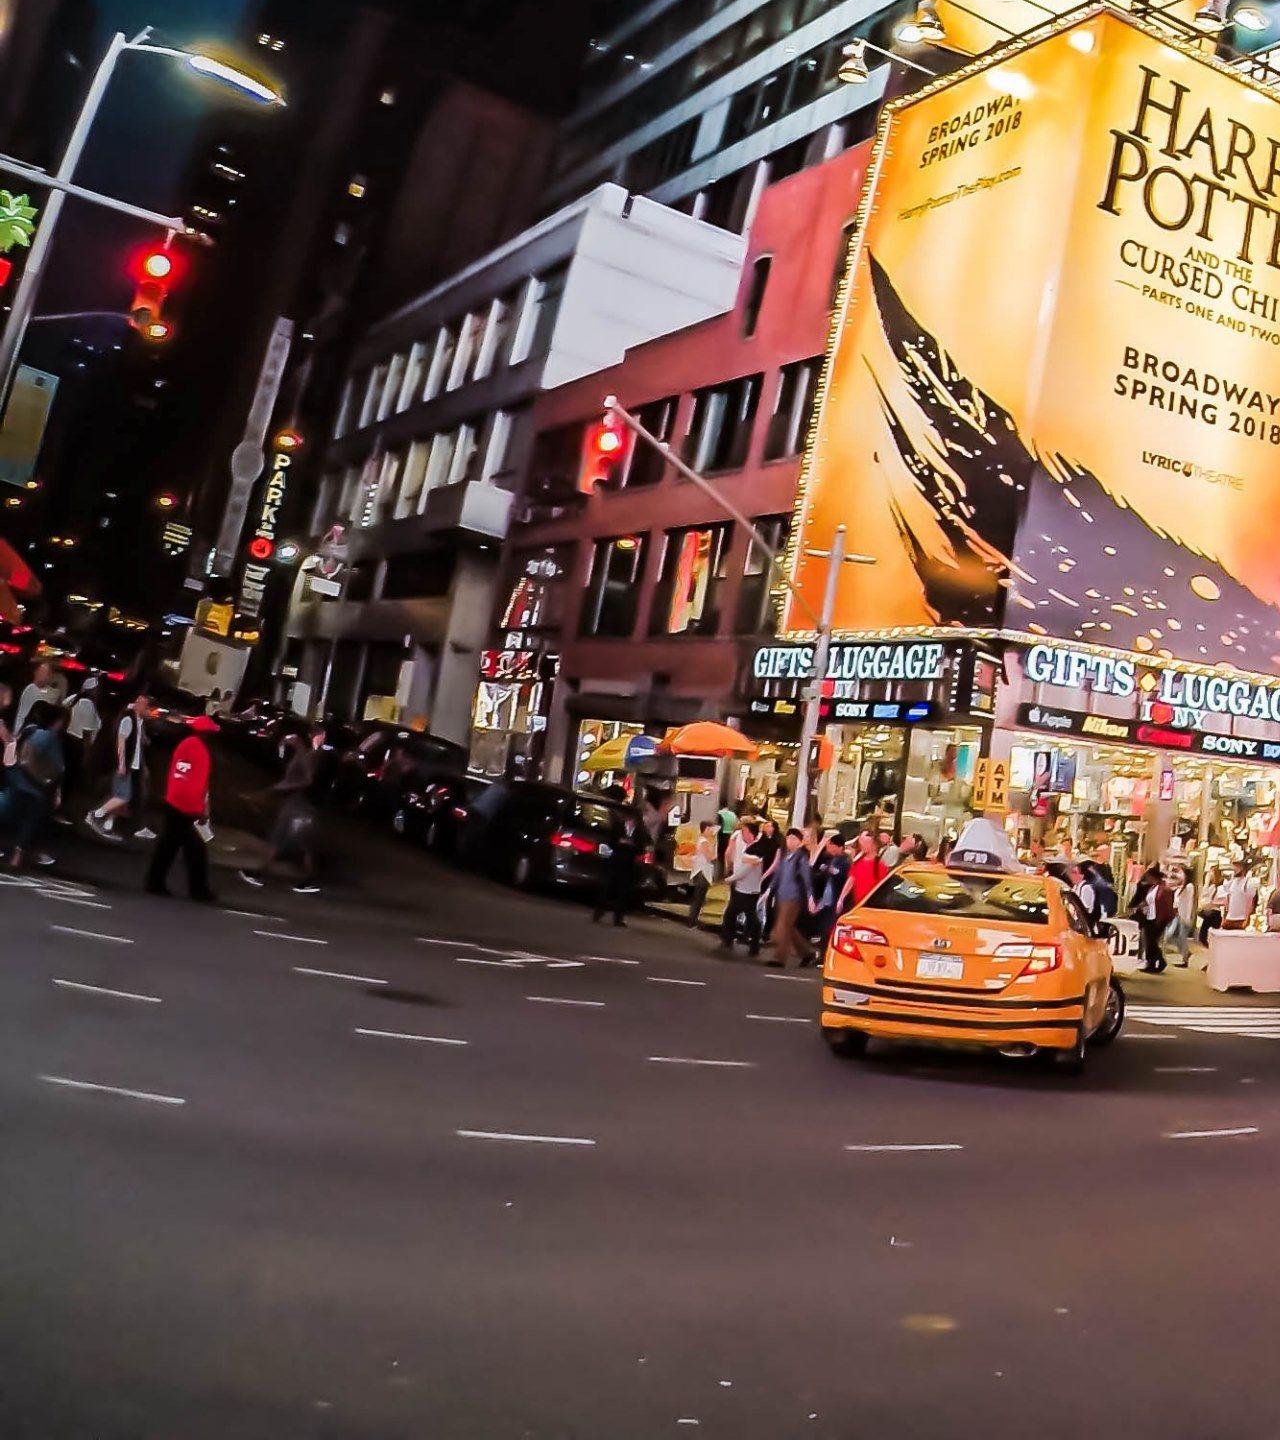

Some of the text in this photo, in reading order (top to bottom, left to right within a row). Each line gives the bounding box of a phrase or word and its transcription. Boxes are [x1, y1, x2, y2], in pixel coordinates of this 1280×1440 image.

[918, 110, 1023, 170] SPRING 2018
[927, 92, 1021, 145] BROADWA
[1119, 239, 1223, 300] CURSED
[1184, 245, 1254, 284] AND THE
[1141, 284, 1182, 310] PARTS
[1184, 301, 1214, 322] ONE
[1216, 313, 1247, 334] AND
[1113, 373, 1218, 426] SPRING
[1141, 450, 1182, 473] LYRIC
[753, 643, 944, 679] GIFTS LUGGAGE
[1026, 643, 1136, 698] GIFTS
[1173, 706, 1204, 729] NY
[1201, 734, 1258, 756] SONY
[991, 763, 1006, 804] ATM
